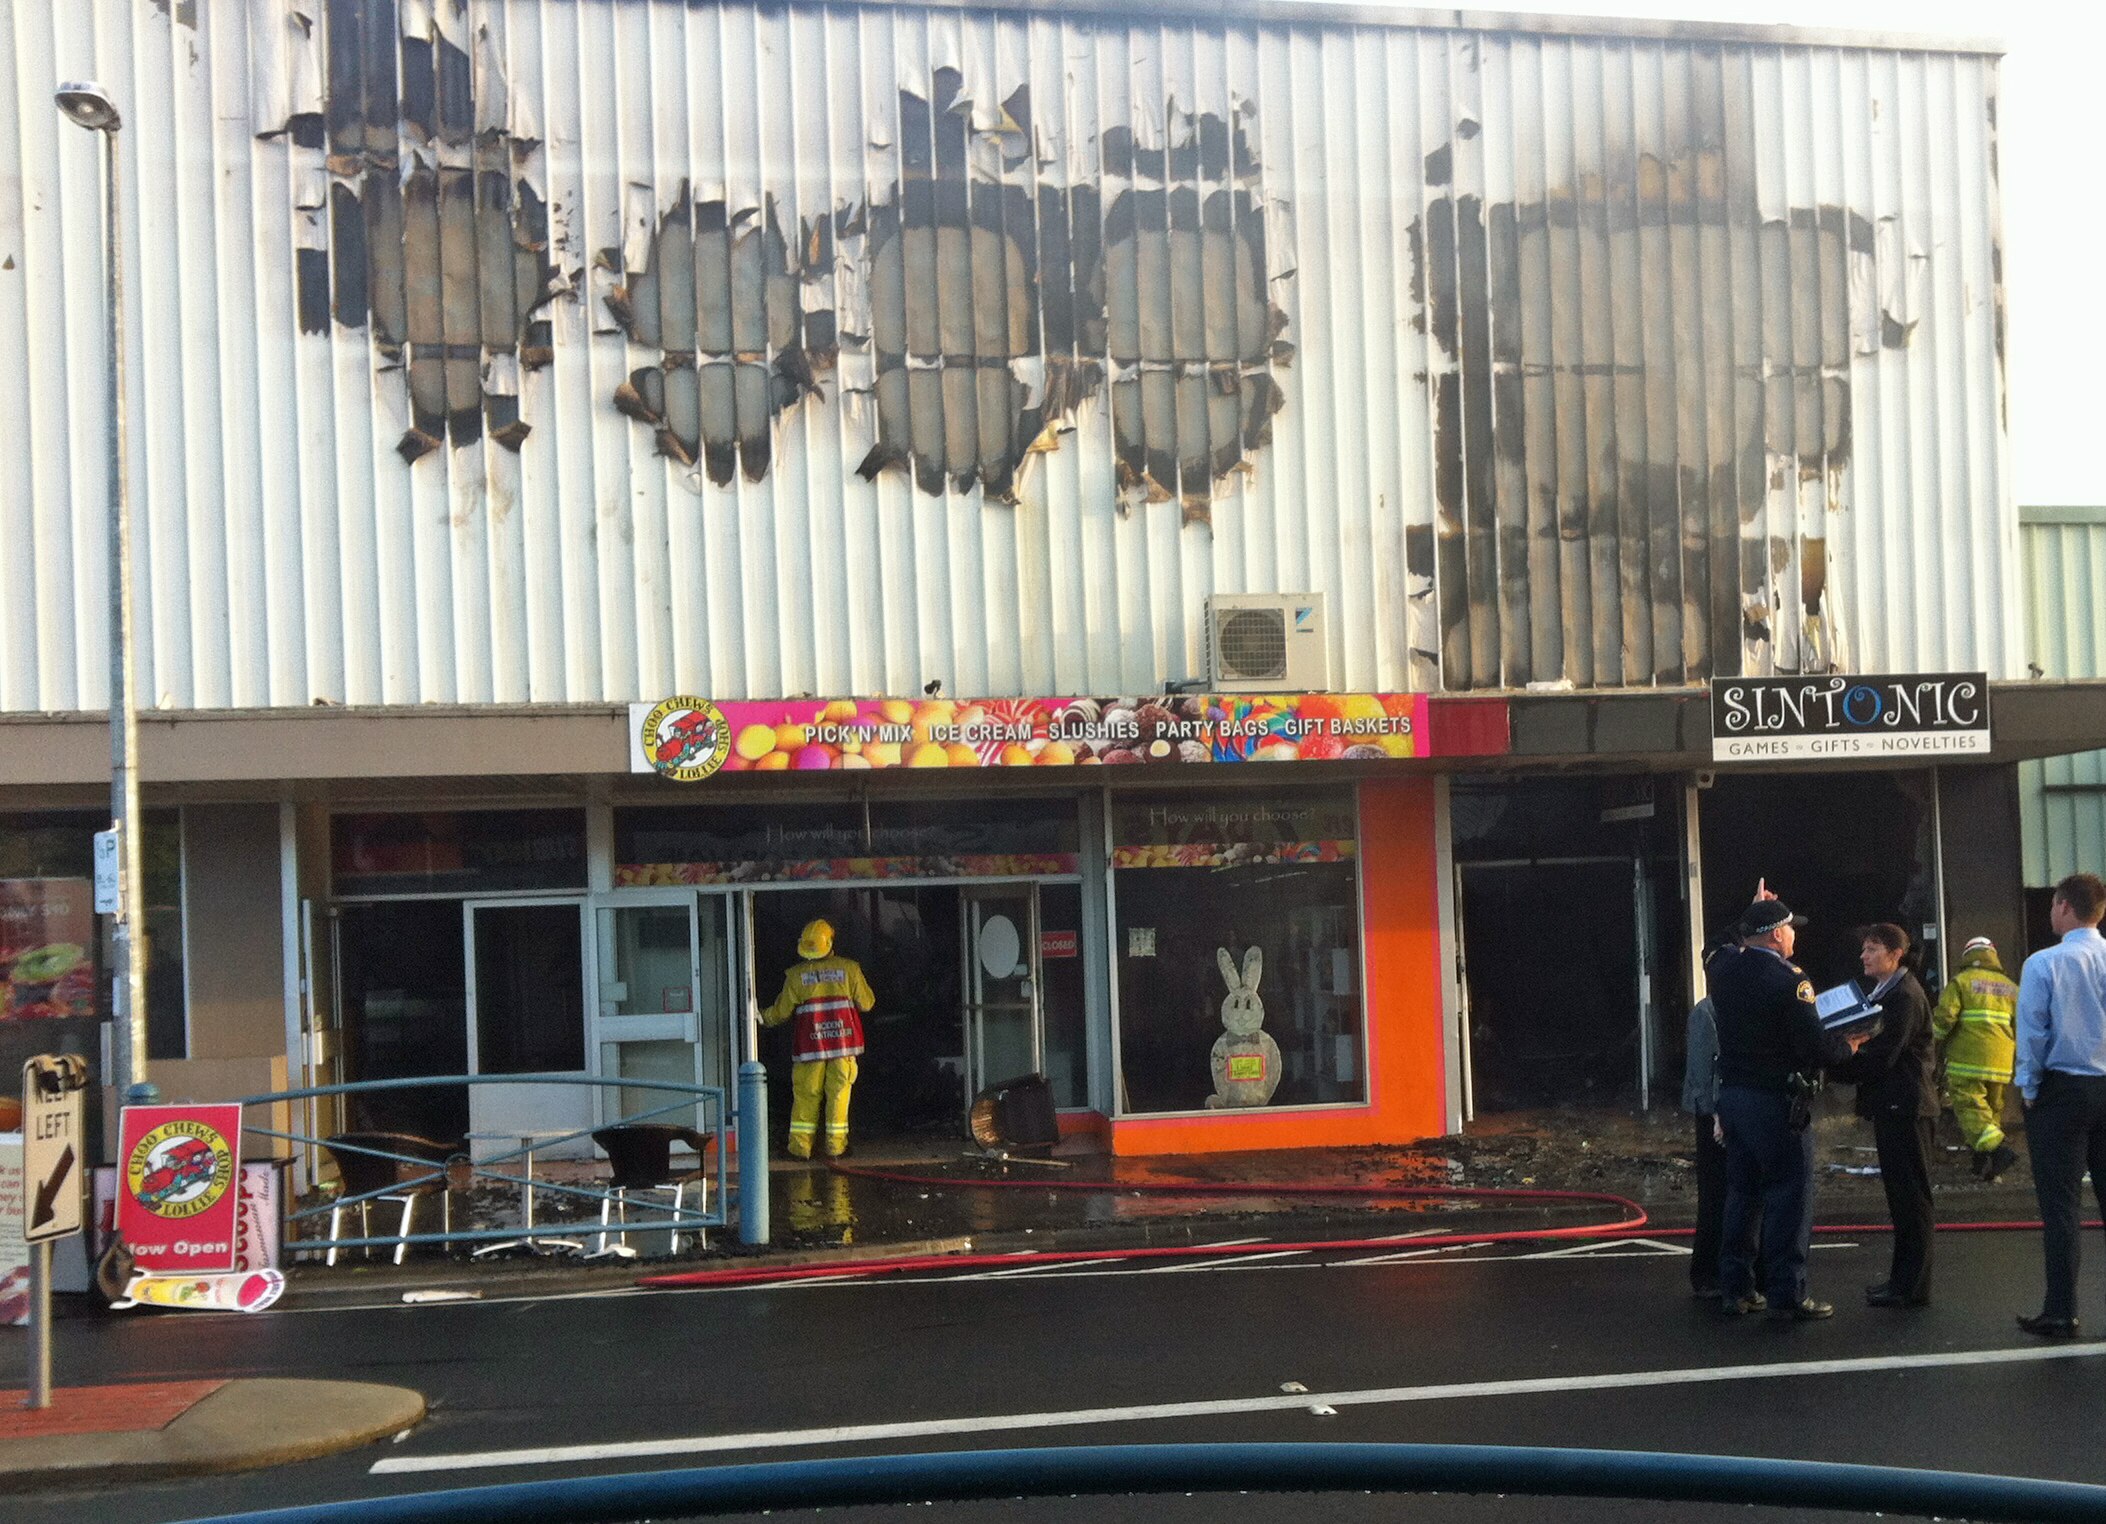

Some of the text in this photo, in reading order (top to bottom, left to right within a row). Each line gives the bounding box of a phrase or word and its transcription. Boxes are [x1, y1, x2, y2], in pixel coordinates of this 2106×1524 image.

[1723, 677, 1979, 731] SINTONIC
[644, 697, 713, 747] CHOO CHEWS
[928, 724, 1032, 742] ICE CREAM
[1048, 722, 1140, 741] SLUSHIES
[1155, 719, 1269, 739] PARTY BAGS
[1284, 716, 1412, 737] GIFT BASKETS
[715, 719, 730, 755] SHOP
[1729, 735, 1977, 756] GAMES GIFTS NOVELTIES
[1149, 806, 1189, 827] How
[1193, 806, 1217, 823] will
[1219, 810, 1249, 828] you
[36, 1111, 70, 1140] LEFT
[128, 1121, 218, 1176] CHOO CHEWS
[162, 1149, 231, 1216] LOLLIE SHOP
[173, 1240, 228, 1258] Open
